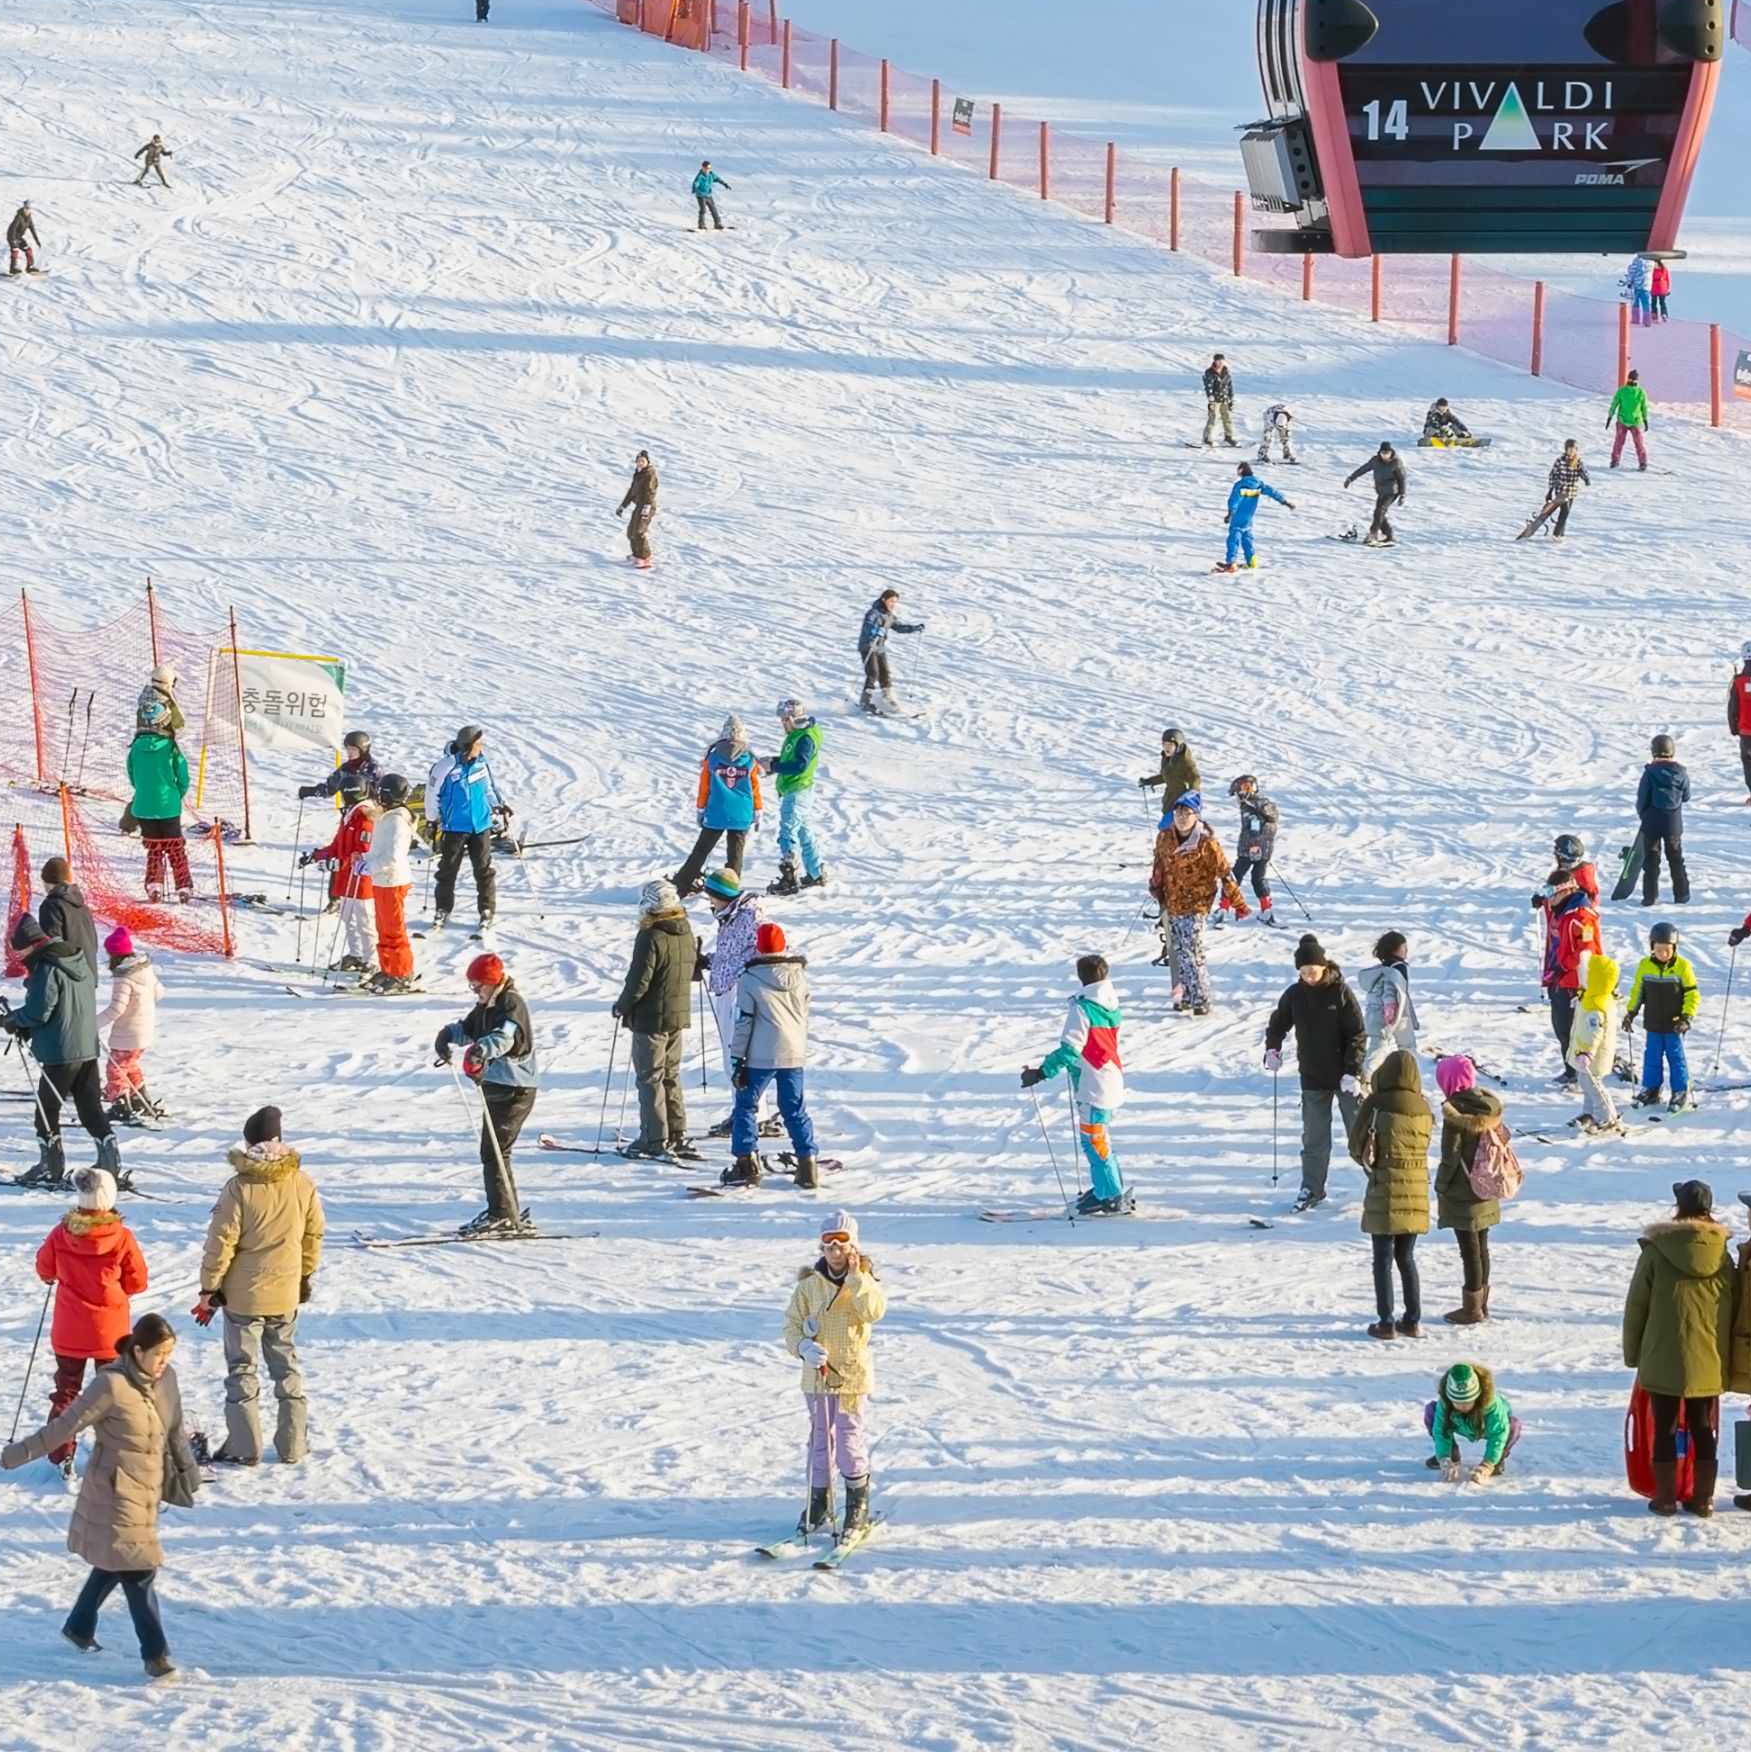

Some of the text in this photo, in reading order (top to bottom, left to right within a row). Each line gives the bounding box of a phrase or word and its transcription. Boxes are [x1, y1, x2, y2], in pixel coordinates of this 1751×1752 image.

[1420, 81, 1612, 110] VIVALDI
[1362, 99, 1409, 141] 14
[1453, 121, 1608, 151] PARK
[1574, 173, 1626, 185] POMA
[242, 687, 328, 719] 충돌위험
